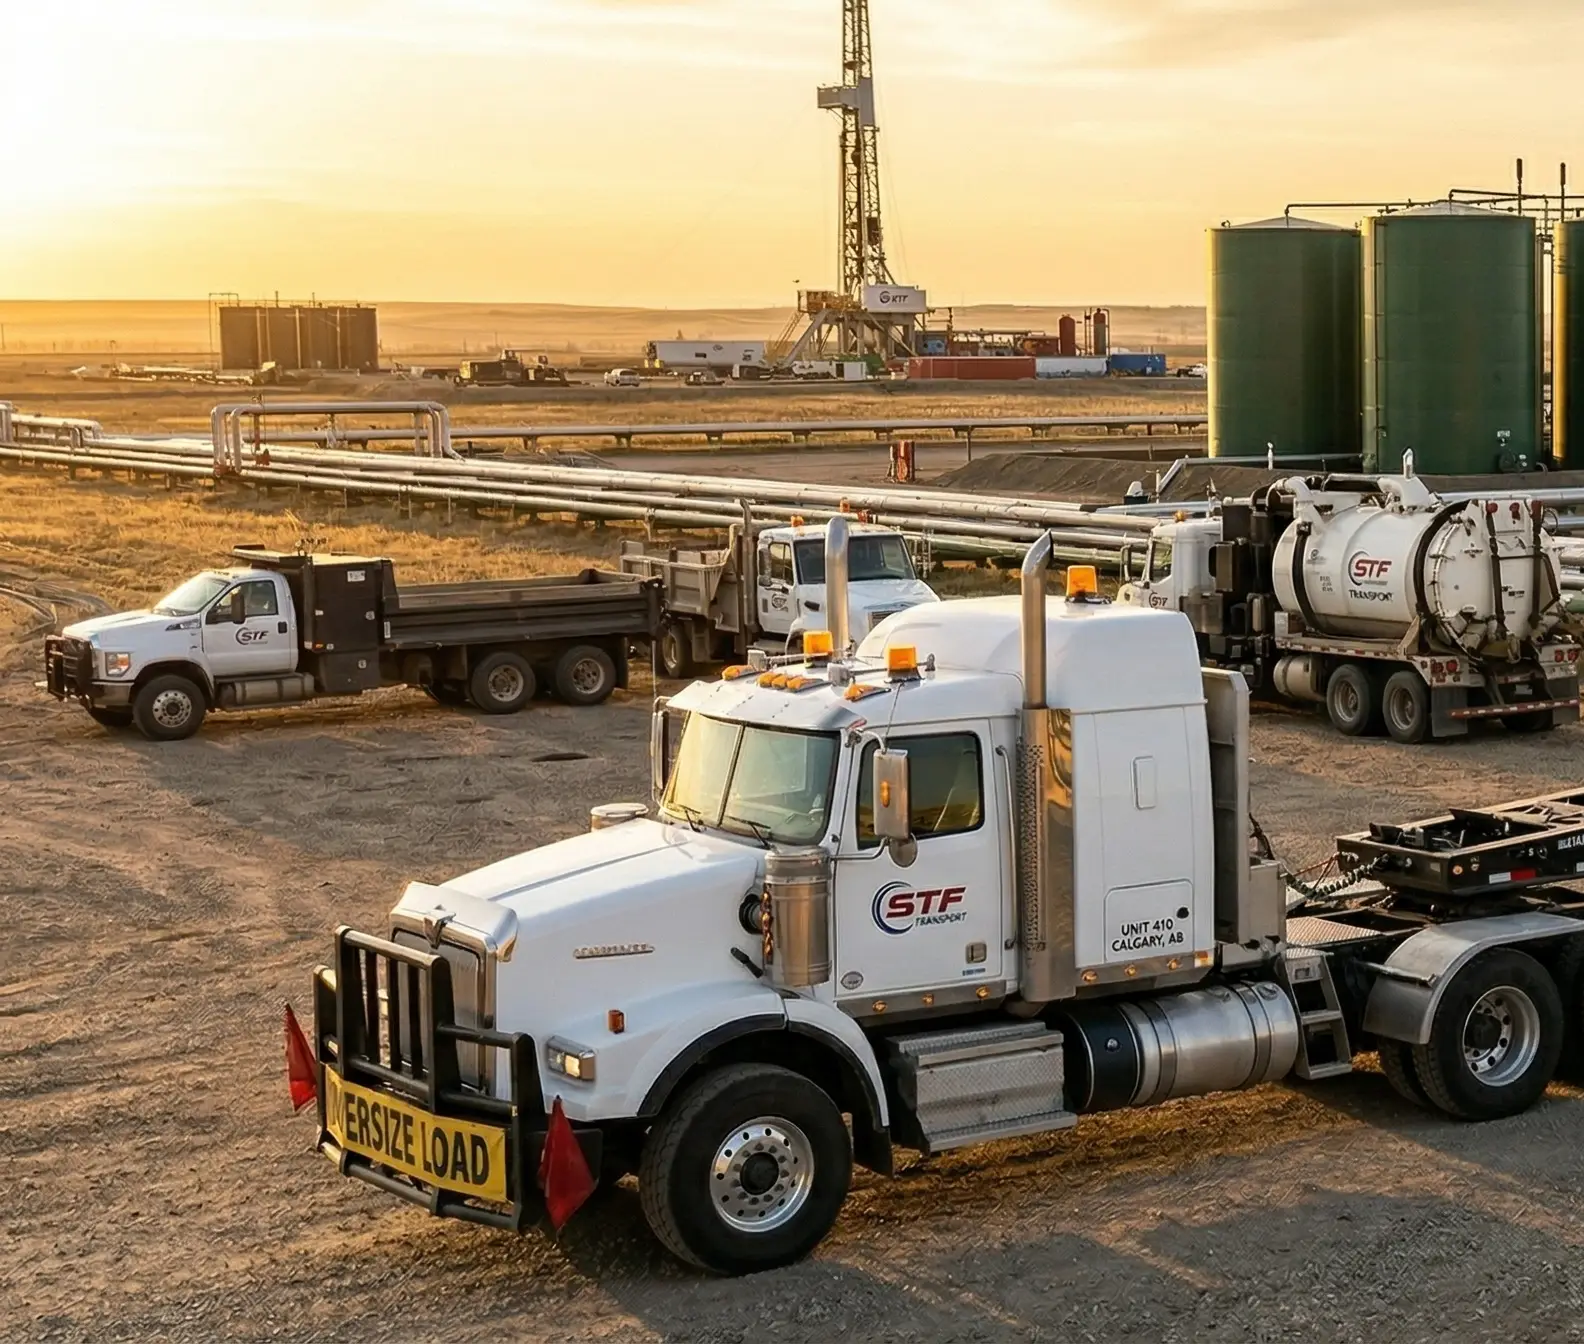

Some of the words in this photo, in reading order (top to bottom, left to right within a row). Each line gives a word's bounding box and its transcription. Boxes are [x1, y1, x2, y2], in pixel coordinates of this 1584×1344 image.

[1354, 559, 1392, 578] STF
[241, 630, 269, 642] STF
[886, 886, 967, 919] STF
[915, 911, 967, 927] TRANSPORT
[1121, 921, 1150, 937] UNIT
[1152, 918, 1174, 932] 410
[1111, 934, 1165, 952] CALGARY,
[1168, 931, 1184, 945] AB
[420, 1121, 490, 1186] LOAD
